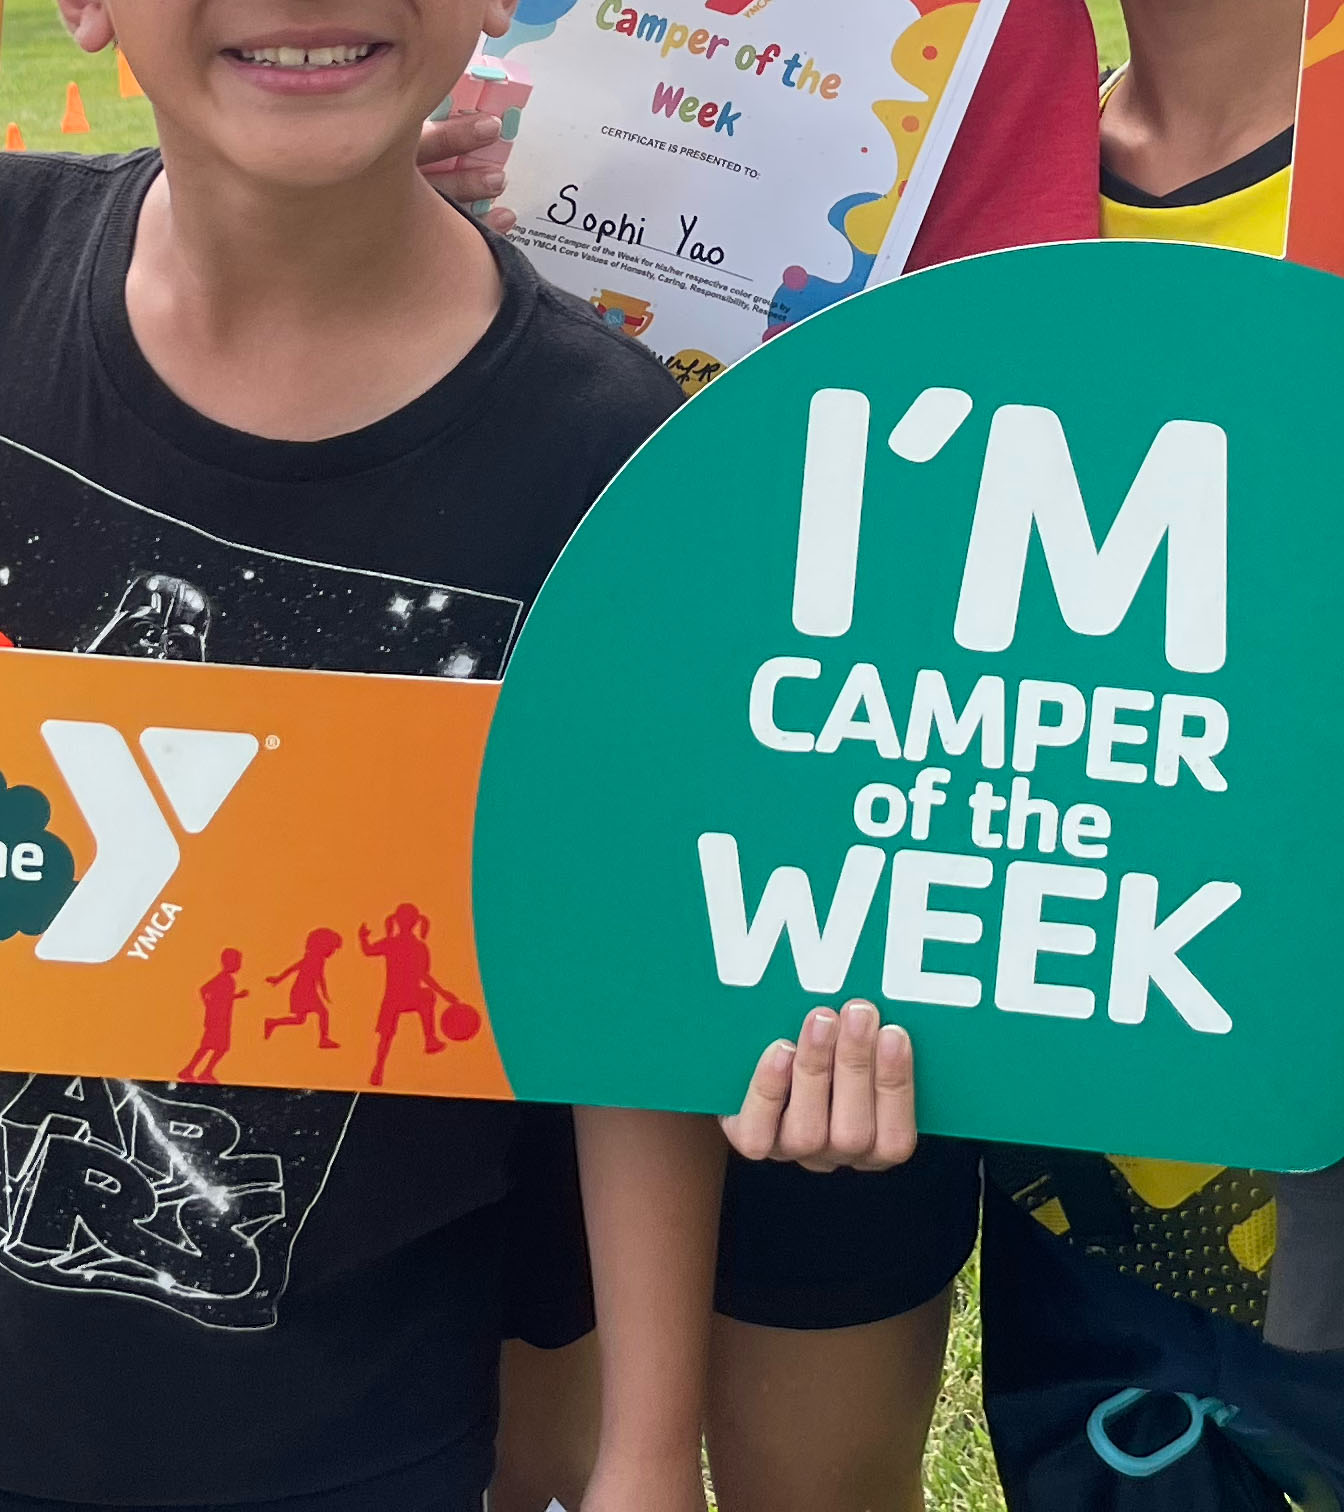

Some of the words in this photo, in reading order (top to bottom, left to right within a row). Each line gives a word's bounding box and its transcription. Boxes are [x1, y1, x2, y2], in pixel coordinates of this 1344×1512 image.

[651, 81, 742, 137] Week
[735, 43, 781, 76] of
[782, 53, 842, 99] the
[601, 125, 667, 151] CERTIFICATE
[668, 144, 678, 154] IS
[679, 146, 742, 173] PRESENTED
[744, 166, 761, 180] TO:
[533, 238, 557, 252] YMCA
[559, 246, 579, 257] Core
[581, 252, 608, 265] Values
[610, 260, 620, 268] of
[547, 184, 645, 246] Sophi
[676, 214, 725, 265] Yao
[528, 229, 556, 241] named
[558, 235, 589, 252] Camper
[591, 245, 601, 253] of
[602, 246, 615, 257] the
[617, 251, 639, 264] Week
[641, 256, 654, 267] for
[655, 262, 684, 277] his/her
[686, 273, 728, 292] respective
[730, 286, 752, 299] color
[753, 295, 777, 310] group
[792, 387, 1228, 674] I'M
[748, 656, 1230, 793] CAMPER
[854, 767, 951, 840] of
[968, 777, 1111, 859] the
[126, 900, 183, 962] YMCA
[696, 832, 1241, 1035] WEEK
